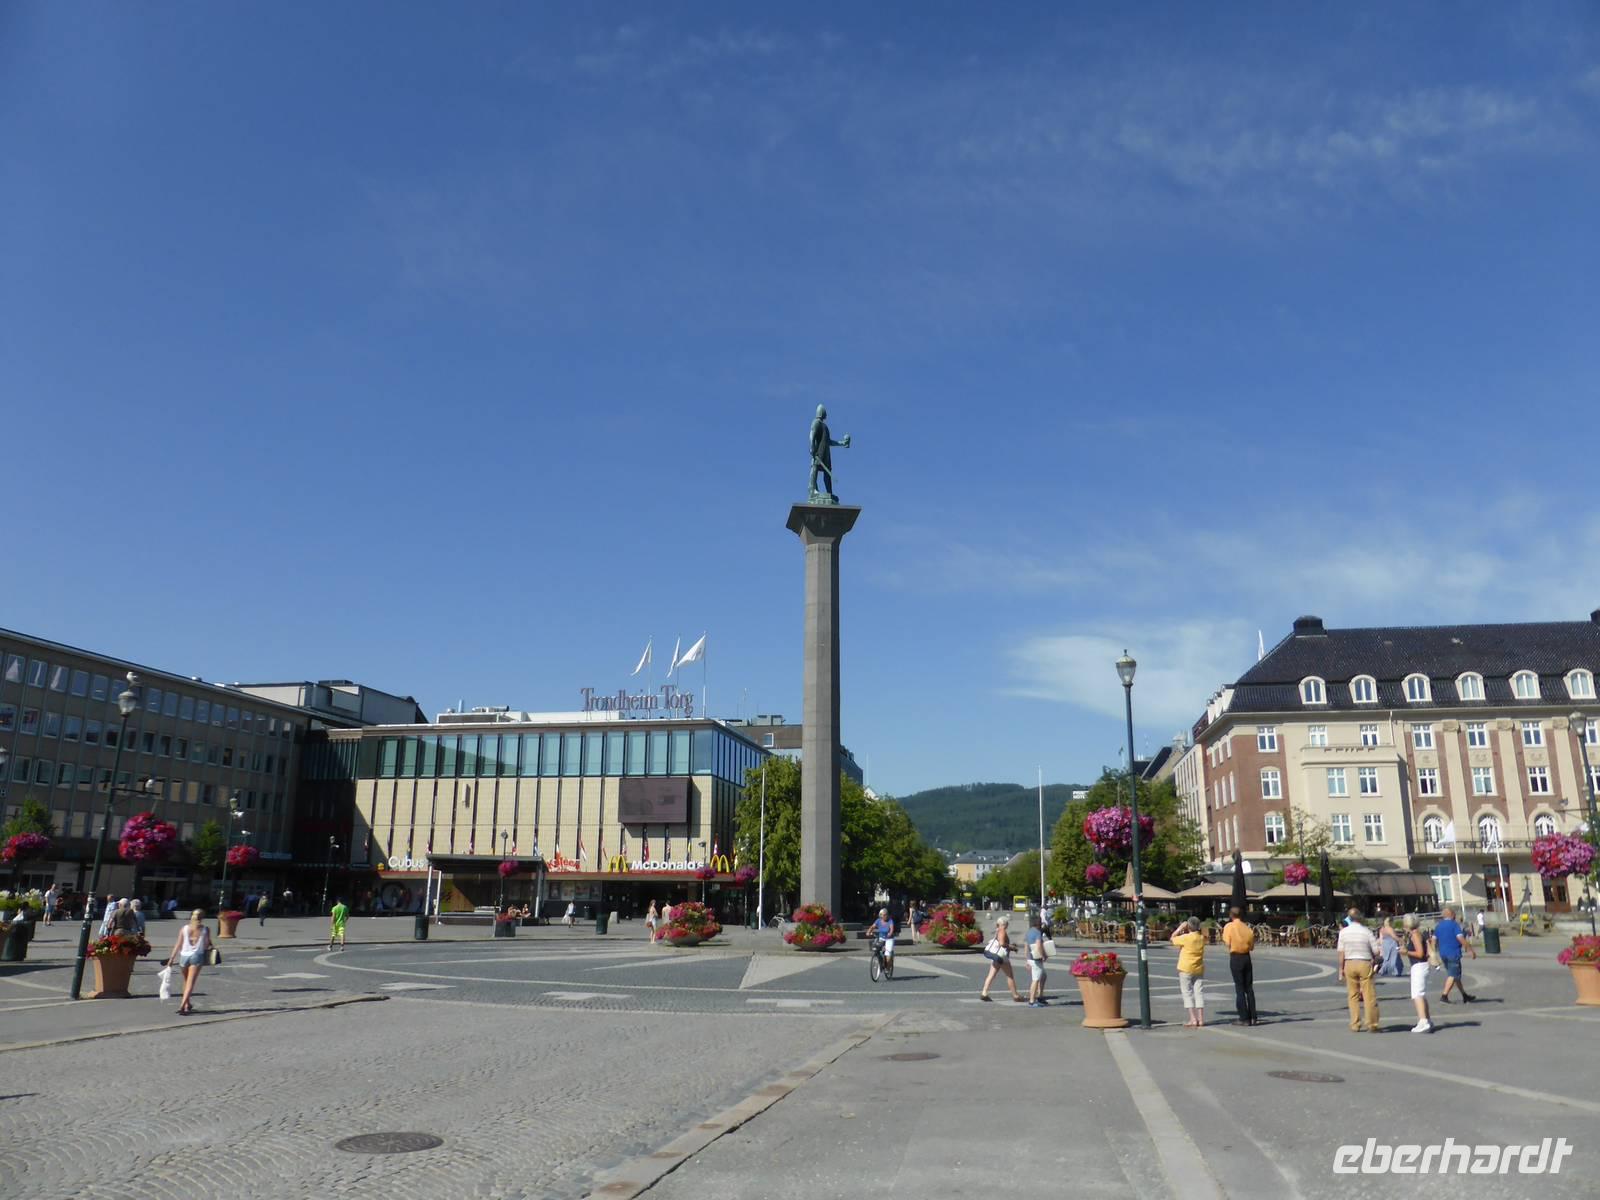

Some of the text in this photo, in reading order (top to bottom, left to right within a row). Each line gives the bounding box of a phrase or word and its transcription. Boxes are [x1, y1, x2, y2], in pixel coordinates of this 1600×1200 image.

[580, 685, 694, 714] Trondheim Torg
[388, 855, 425, 868] Cubus
[631, 860, 705, 870] McDonald's
